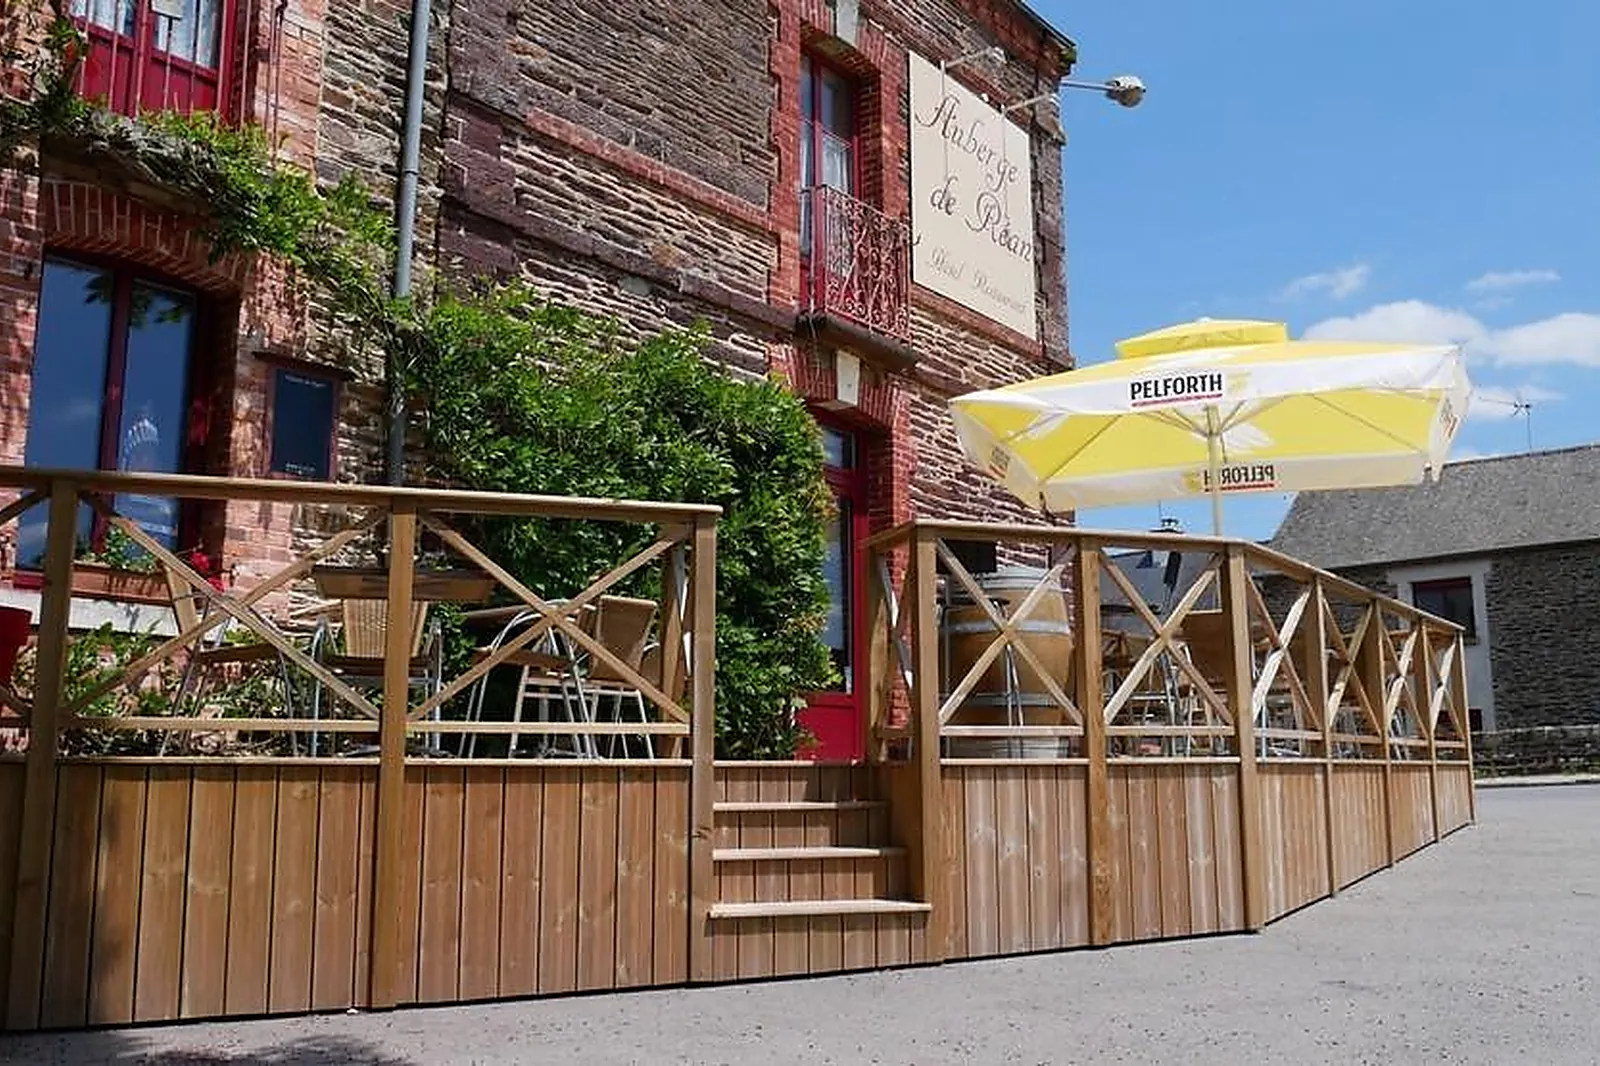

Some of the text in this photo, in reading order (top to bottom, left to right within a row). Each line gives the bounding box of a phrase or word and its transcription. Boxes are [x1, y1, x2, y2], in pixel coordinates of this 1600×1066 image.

[914, 95, 1018, 193] Auberge
[930, 175, 958, 216] de
[1130, 372, 1223, 401] PELFORTH
